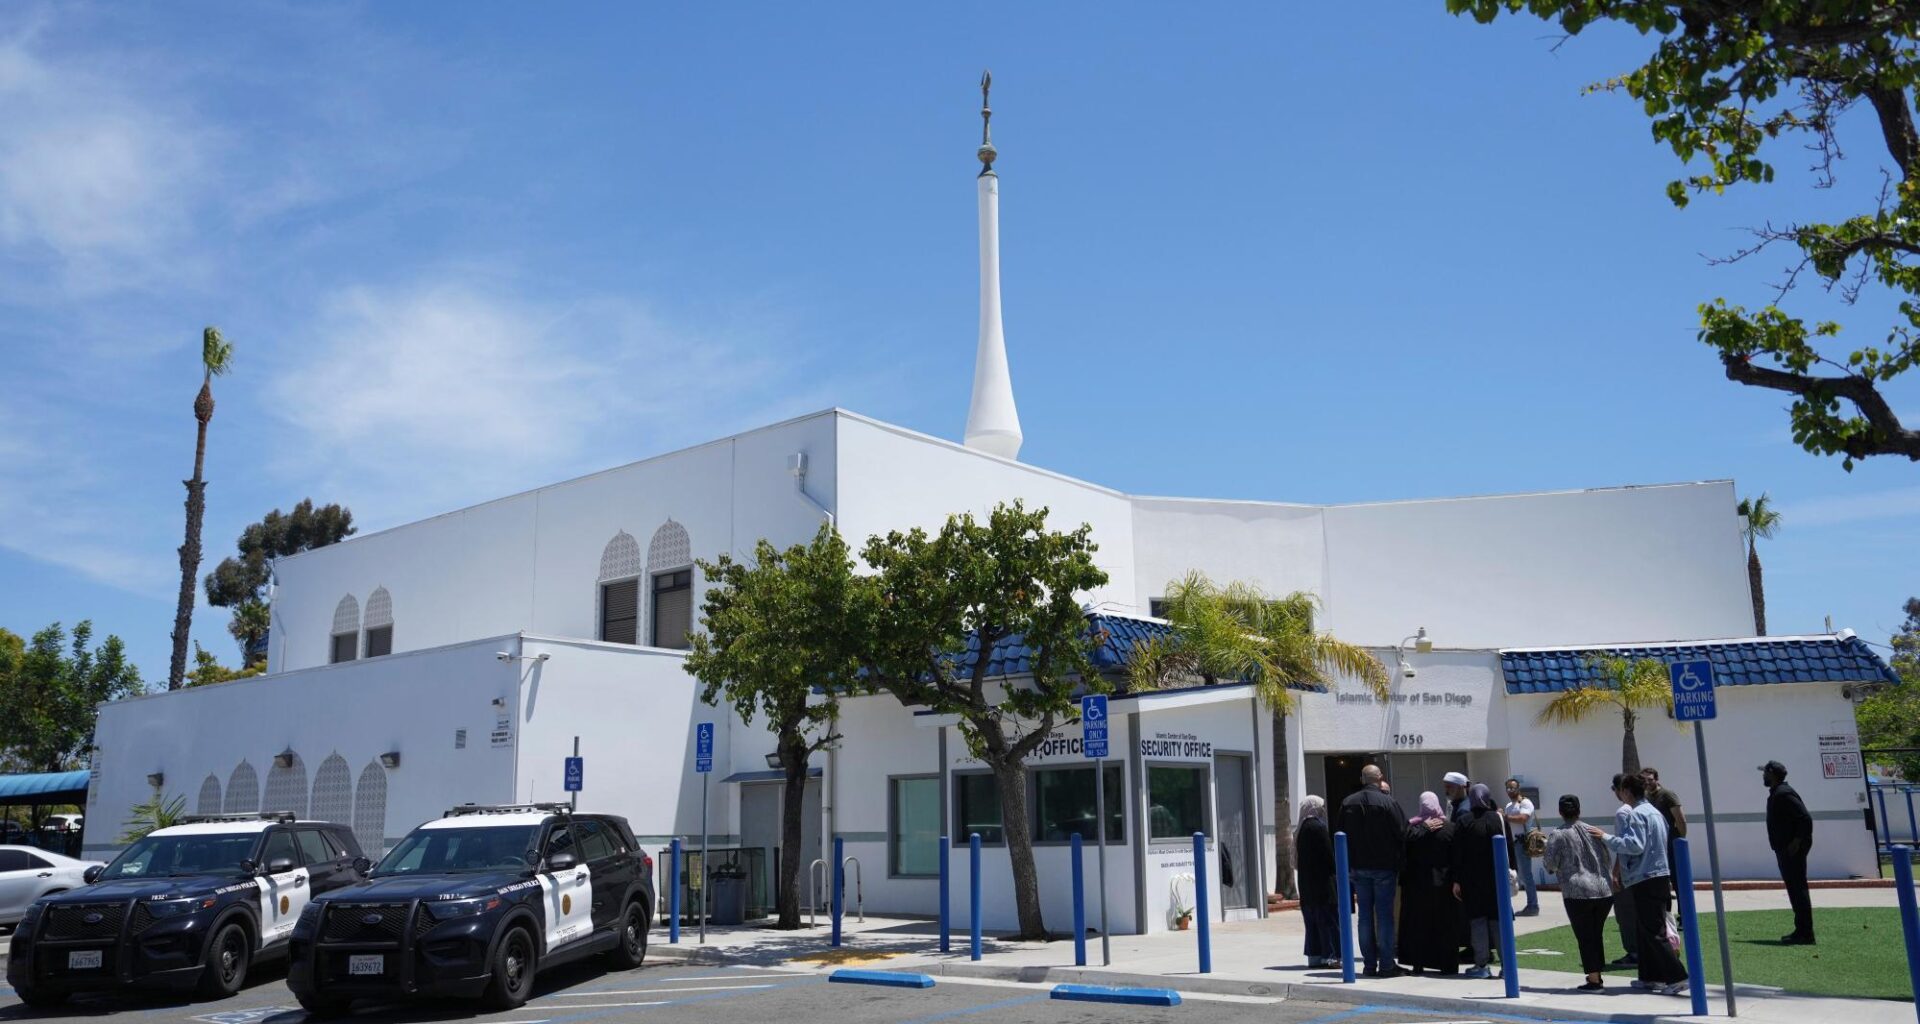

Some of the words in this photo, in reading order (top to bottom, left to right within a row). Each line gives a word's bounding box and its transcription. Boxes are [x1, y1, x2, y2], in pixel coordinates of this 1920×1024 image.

[1335, 692, 1372, 705] Islamic
[1409, 692, 1420, 705] of
[1422, 692, 1442, 705] San
[1445, 692, 1473, 707] Diego
[1674, 690, 1713, 704] PARKING
[1683, 705, 1707, 718] ONLY
[1084, 720, 1107, 730] PARKING
[1088, 730, 1103, 740] ONLY
[1393, 734, 1424, 745] 7050
[1141, 739, 1182, 757] SECURITY
[1184, 741, 1212, 758] OFFICE
[241, 881, 257, 890] POLICE
[497, 886, 509, 895] SAN
[507, 882, 525, 892] DIEGO
[523, 879, 541, 889] POLICE
